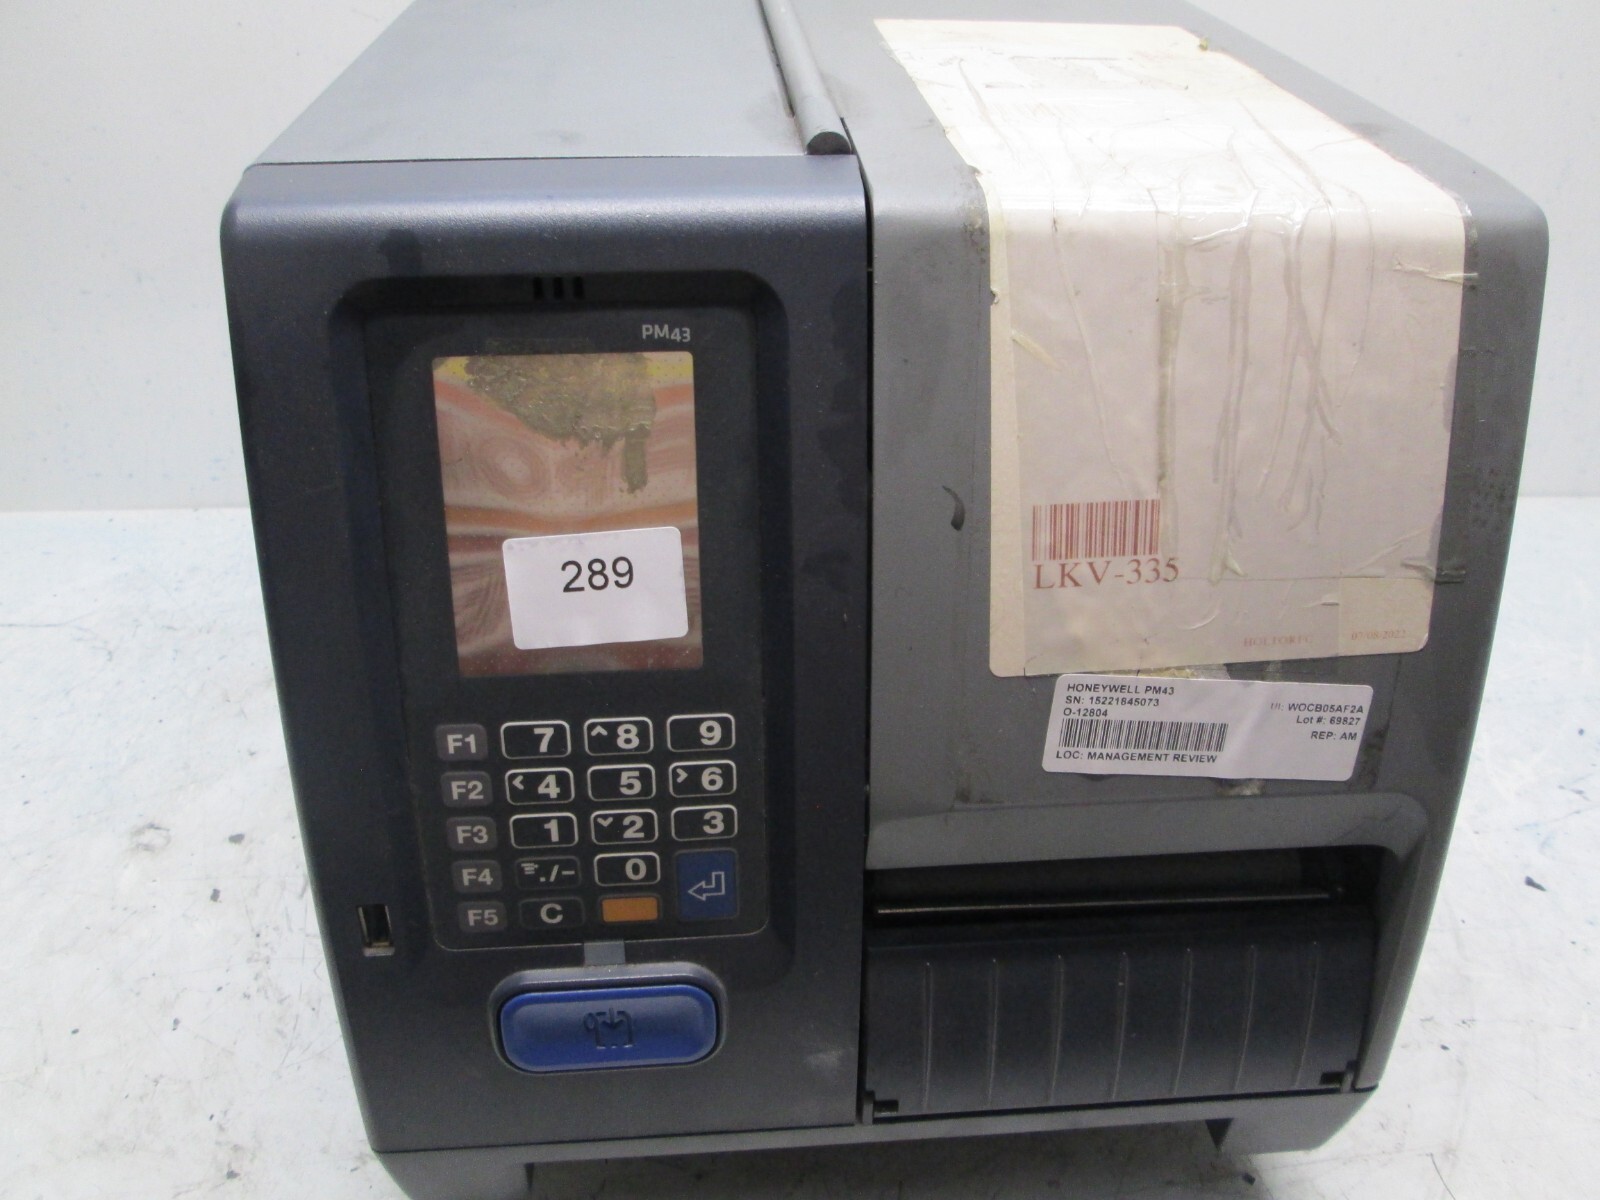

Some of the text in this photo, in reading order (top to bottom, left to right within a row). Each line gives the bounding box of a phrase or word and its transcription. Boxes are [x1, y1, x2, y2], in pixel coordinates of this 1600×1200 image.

[641, 324, 691, 343] PM43
[560, 556, 635, 593] 289
[1032, 556, 1180, 590] LKV-335
[1067, 683, 1175, 696] HONEYWELL PM43
[1065, 695, 1160, 707] SN: 15221845073
[1296, 715, 1313, 724] Lot
[1329, 716, 1361, 726] 69827
[533, 728, 555, 752] 7
[617, 724, 640, 749] 8
[700, 721, 722, 745] 9
[1310, 730, 1358, 741] REP: AM
[447, 735, 476, 754] F1
[1056, 750, 1218, 763] LOC: MANAGEMENT REVIEW
[538, 775, 561, 798] 4
[620, 772, 641, 795] 5
[701, 767, 723, 790] 6
[451, 781, 483, 800] F2
[544, 819, 559, 842] 1
[623, 816, 644, 838] 2
[703, 812, 724, 834] 3
[457, 826, 488, 844] F3
[462, 869, 493, 886] F4
[625, 859, 647, 880] 0
[468, 910, 498, 926] F5
[541, 904, 563, 923] C
